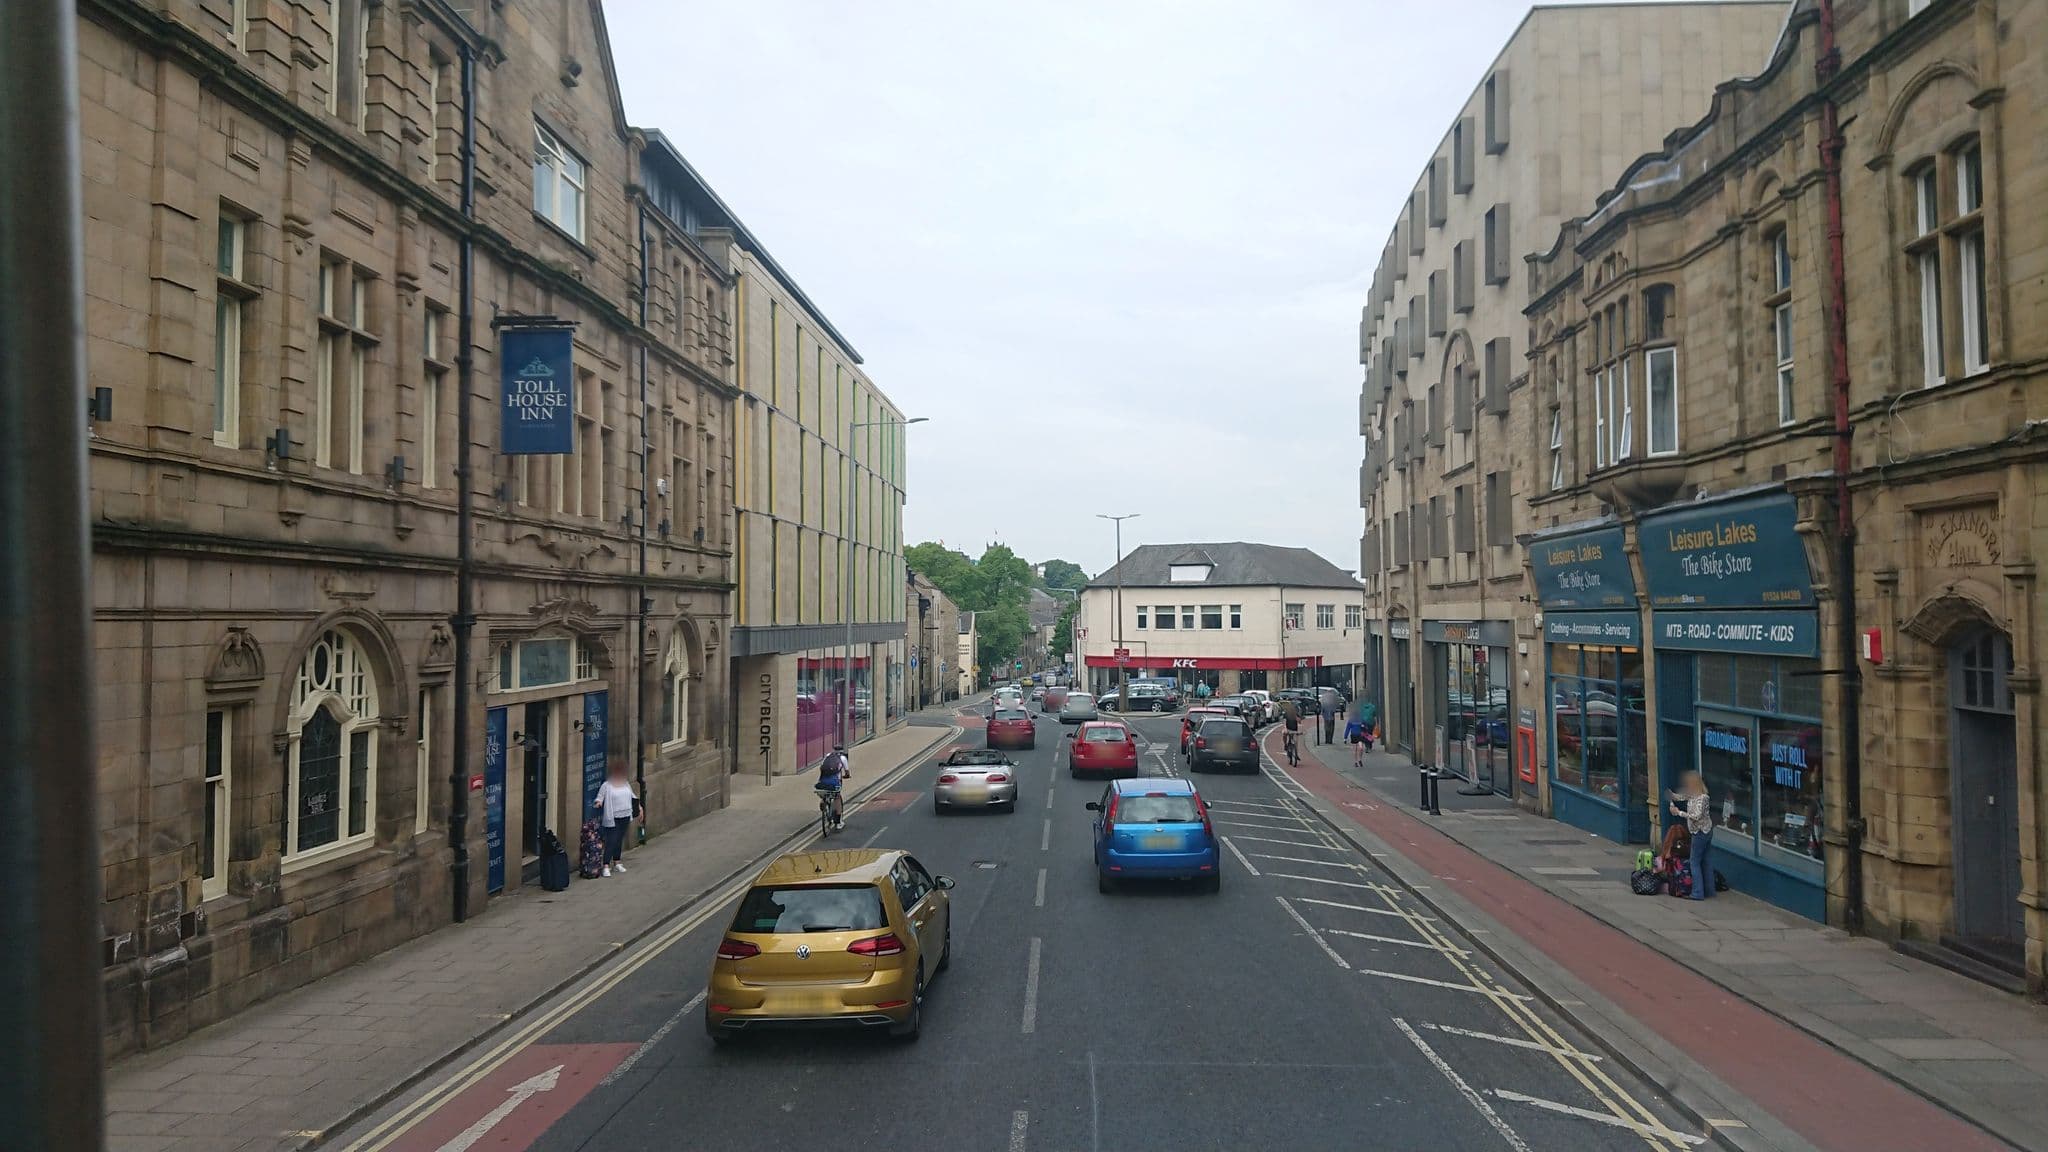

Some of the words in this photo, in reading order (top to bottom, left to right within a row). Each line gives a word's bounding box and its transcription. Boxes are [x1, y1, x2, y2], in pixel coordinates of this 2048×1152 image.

[514, 380, 560, 393] TOLL
[508, 393, 567, 407] HOUSE
[521, 407, 553, 420] INN
[1669, 529, 1714, 551] Leisure
[1715, 521, 1757, 546] Lakes
[1547, 548, 1576, 566] Leisure
[1577, 543, 1602, 562] Lakes
[1682, 554, 1700, 577] The
[1701, 552, 1723, 580] Bike
[1725, 553, 1752, 576] Store
[1557, 571, 1570, 589] The
[1584, 571, 1600, 588] Store
[1551, 622, 1570, 637] Clothing
[1605, 622, 1631, 640] Servicing
[1666, 623, 1683, 638] MTB
[1688, 623, 1711, 639] ROAD
[1717, 624, 1763, 641] COMMUTE
[1770, 625, 1795, 642] KIDS
[1172, 659, 1197, 668] KFC
[760, 673, 771, 756] CITYBLOCK
[1771, 743, 1788, 763] JUST
[1789, 746, 1807, 769] ROLL
[1775, 766, 1793, 788] WITH
[1794, 769, 1802, 790] IT
